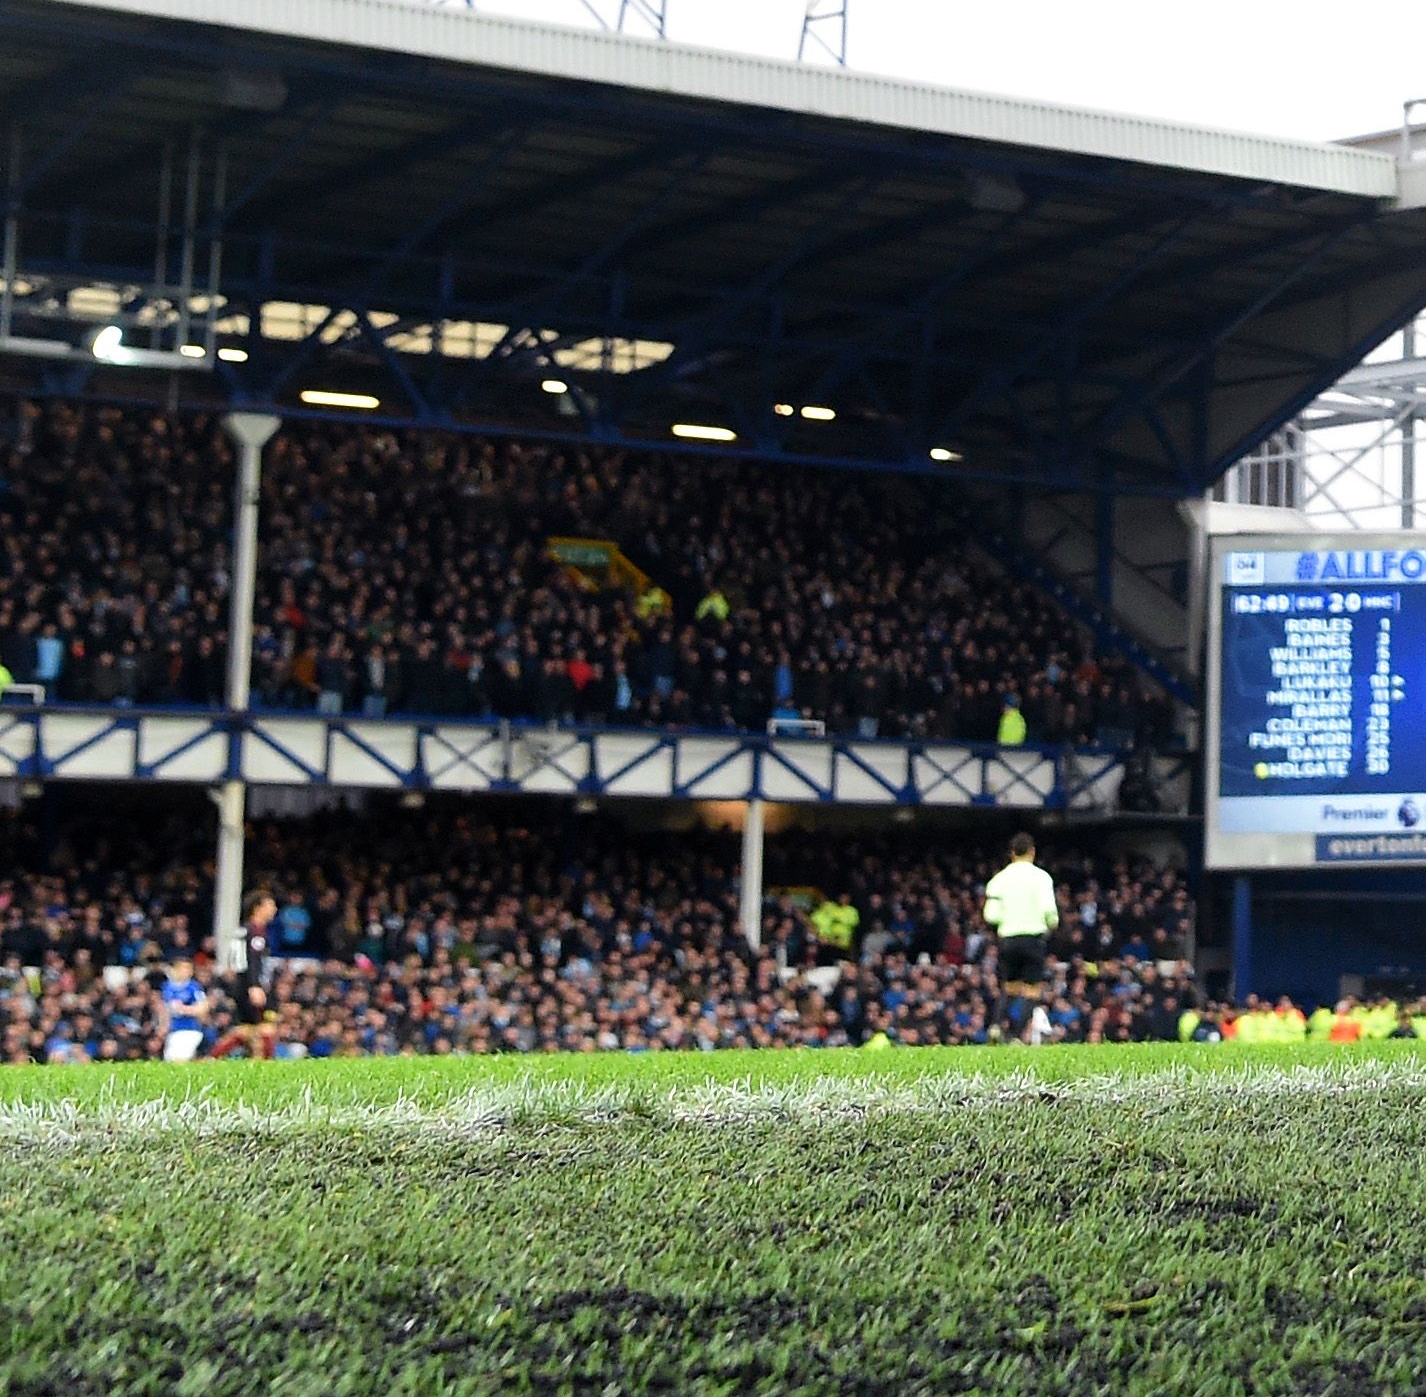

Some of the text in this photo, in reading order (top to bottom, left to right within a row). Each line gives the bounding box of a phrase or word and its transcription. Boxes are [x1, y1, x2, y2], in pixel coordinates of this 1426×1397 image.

[1285, 618, 1353, 633] ROBLES
[1270, 647, 1352, 661] WILLIAMS
[1272, 661, 1352, 676] BARKLEY
[1281, 675, 1352, 689] LUKAKU
[1266, 717, 1352, 732] COLEMAN
[1268, 761, 1349, 777] HOLGATE
[1323, 803, 1389, 820] Premier
